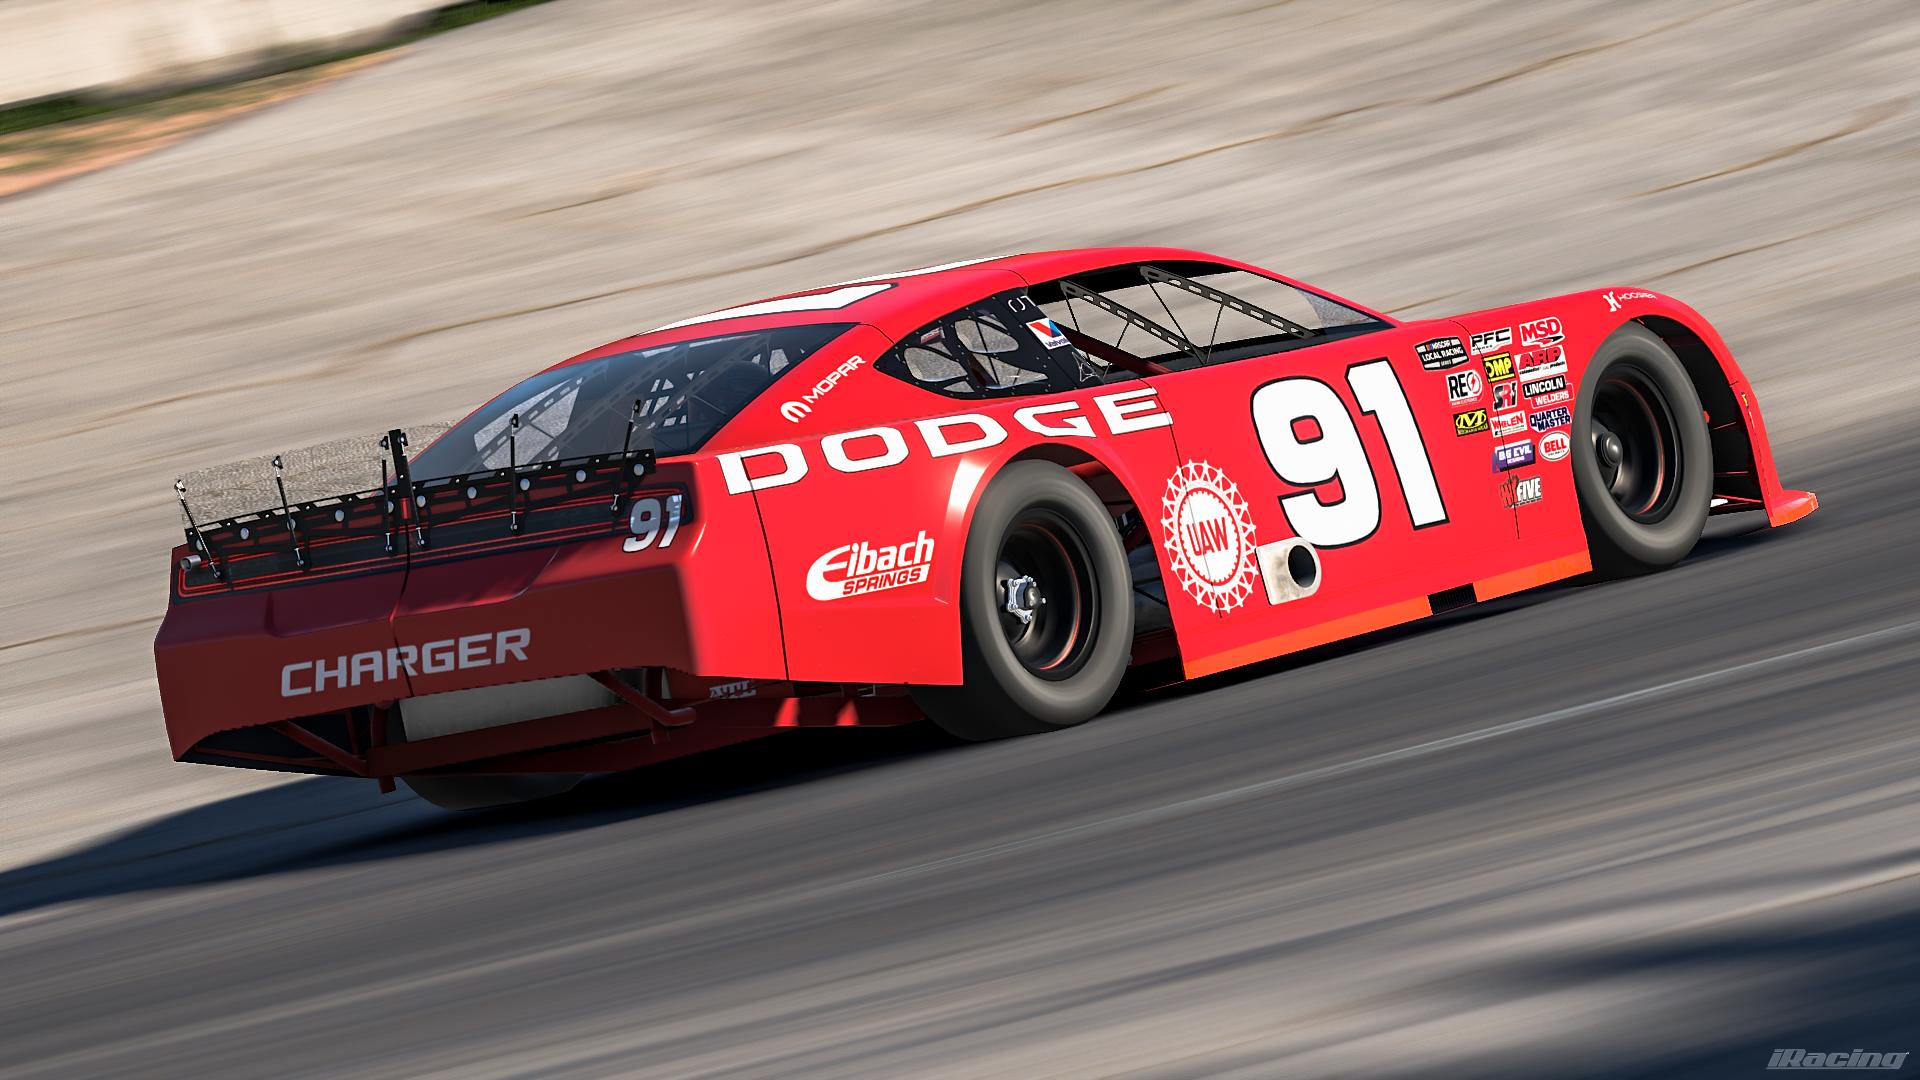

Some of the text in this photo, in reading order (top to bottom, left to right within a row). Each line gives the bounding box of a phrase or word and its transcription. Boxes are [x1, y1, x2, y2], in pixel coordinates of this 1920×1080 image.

[1471, 328, 1511, 348] PFC
[1521, 318, 1561, 342] MSD
[1421, 352, 1442, 362] LOCAL
[1441, 347, 1464, 358] RACING
[1519, 346, 1562, 370] ARP
[801, 355, 866, 404] MOPAR
[1485, 357, 1512, 378] OMP
[1524, 377, 1564, 396] LINCOLN
[1535, 390, 1570, 406] WELDERS
[1529, 407, 1567, 427] QUARTER
[1537, 415, 1570, 432] MASTER
[716, 387, 1174, 496] DODGE
[1250, 356, 1450, 550] 91
[1513, 445, 1532, 457] EVIL
[1544, 438, 1567, 453] BELL
[1516, 477, 1541, 502] FIVE
[622, 494, 683, 553] 91
[1187, 516, 1229, 556] UAW
[806, 530, 935, 601] Eibach
[842, 566, 922, 596] SPRINGS
[281, 627, 531, 698] CHARGER
